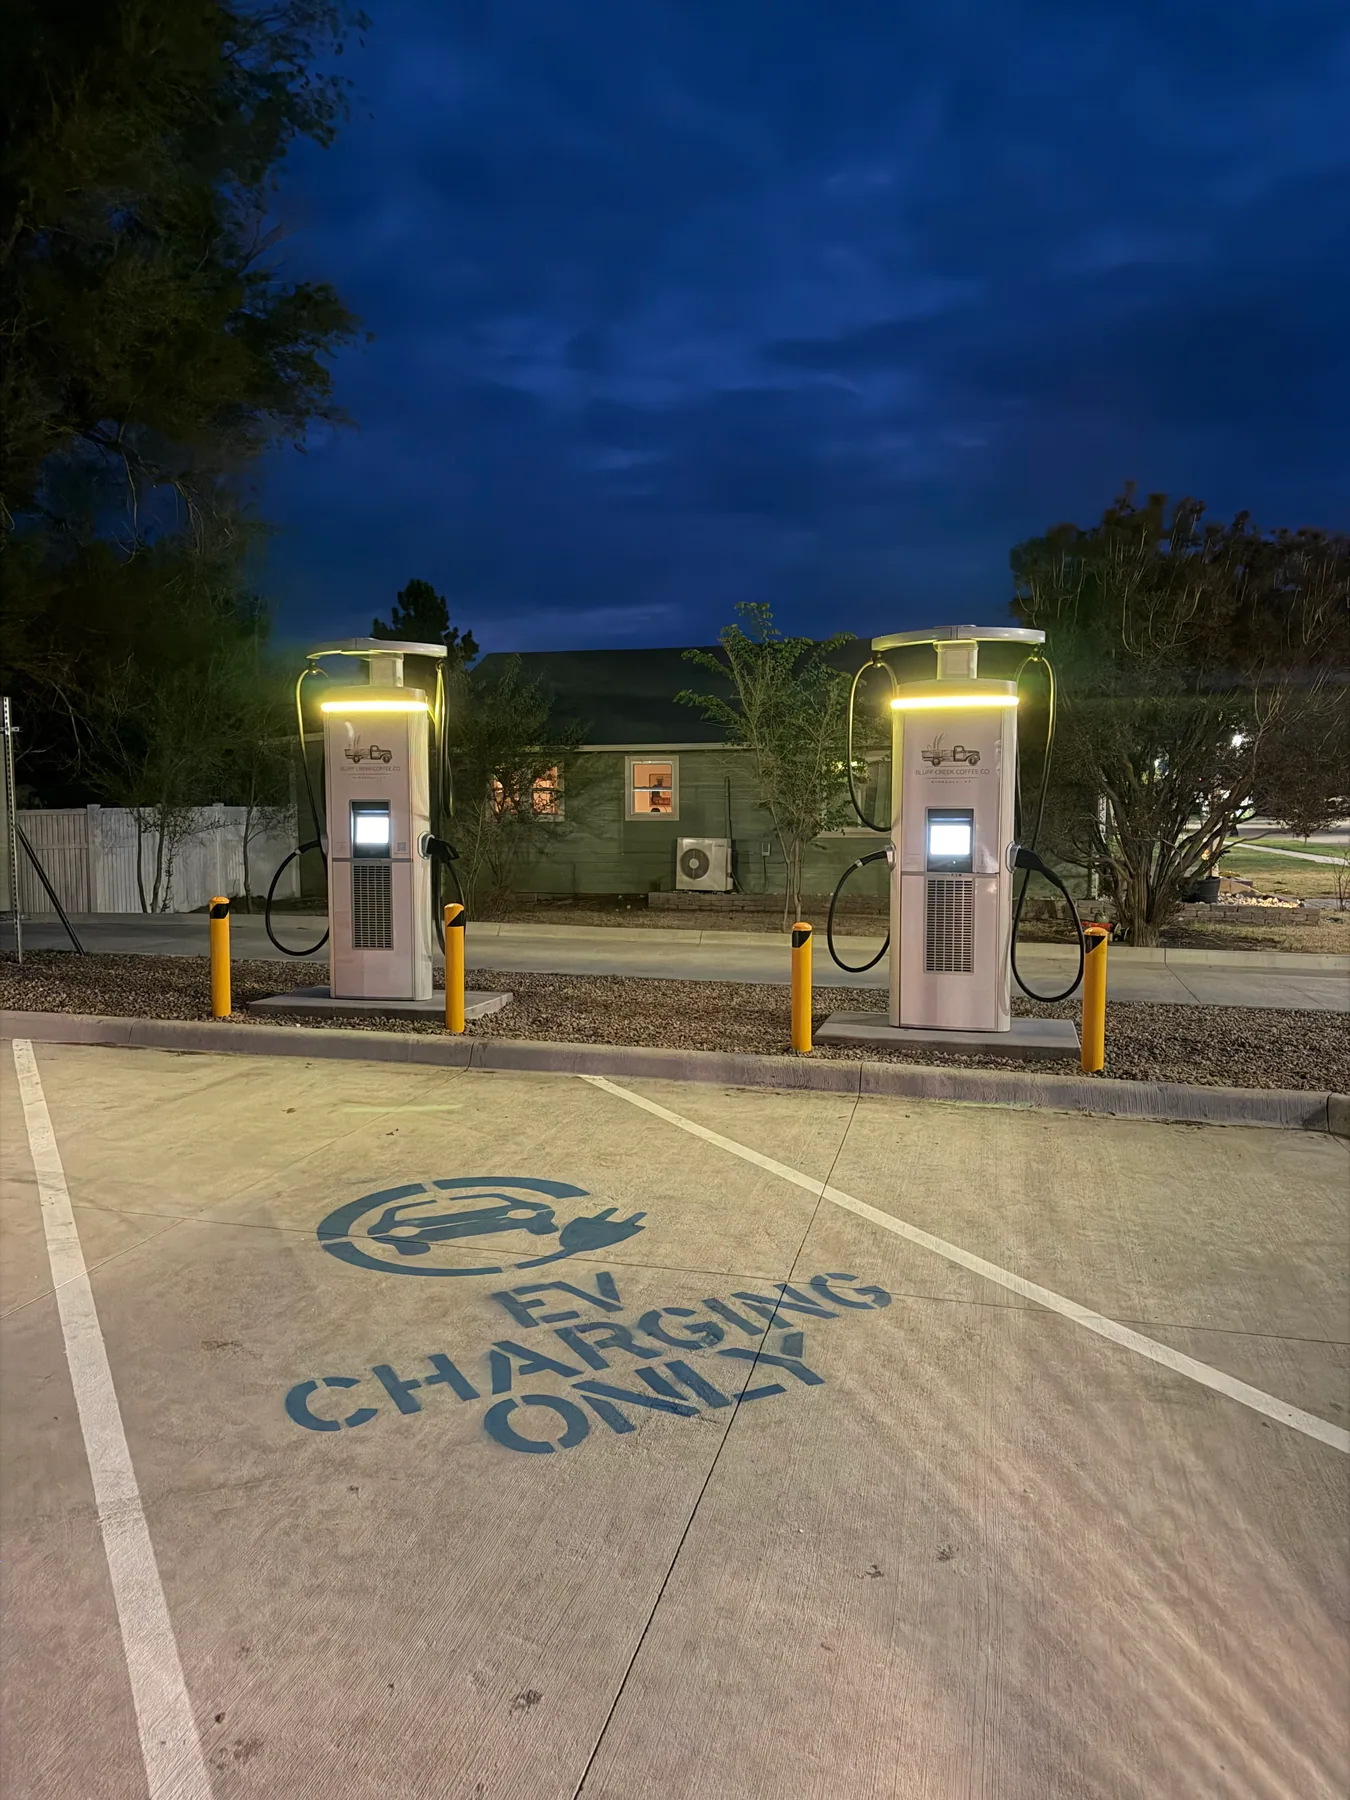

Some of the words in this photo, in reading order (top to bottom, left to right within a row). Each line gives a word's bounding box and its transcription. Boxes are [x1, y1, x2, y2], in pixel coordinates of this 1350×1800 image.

[284, 1272, 892, 1432] CHARGING
[491, 1271, 624, 1328] EV
[484, 1331, 826, 1453] ONLY
